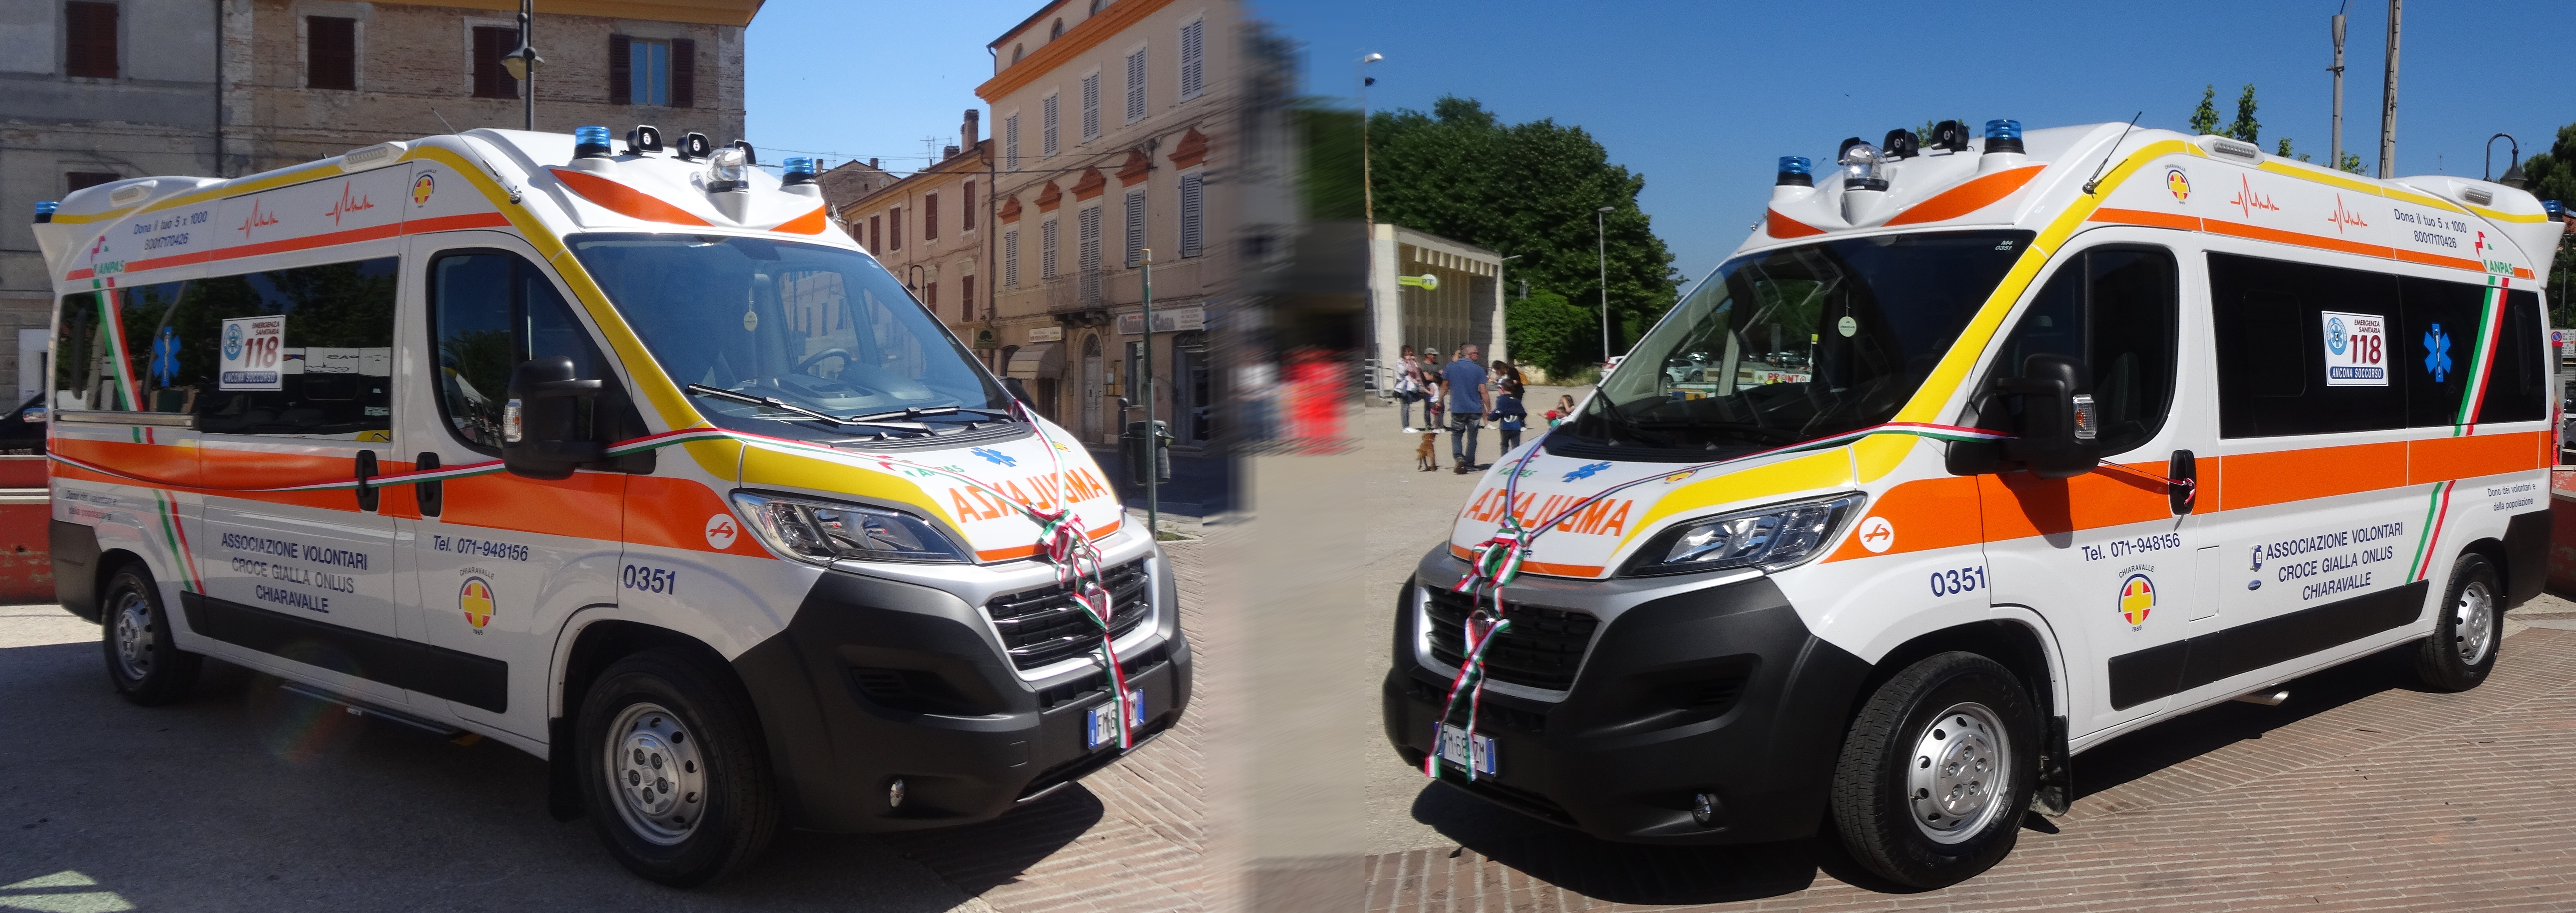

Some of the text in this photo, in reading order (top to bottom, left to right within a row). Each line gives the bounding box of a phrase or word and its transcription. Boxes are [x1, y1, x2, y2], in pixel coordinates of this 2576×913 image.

[133, 224, 151, 235] Dona
[154, 220, 158, 231] il
[160, 220, 172, 230] tuo
[175, 216, 180, 227] 5
[191, 211, 208, 224] 1000
[2394, 208, 2467, 233] Dona il tuo 5 x 1000
[144, 233, 189, 250] 80017170426
[2414, 230, 2457, 249] 80017170426
[99, 259, 125, 275] ANPAS
[2490, 260, 2513, 275] ANPAS
[245, 336, 279, 368] 118
[2349, 334, 2381, 365] 118
[225, 373, 244, 382] ANCONA
[246, 372, 275, 382] SOCCORSO
[2332, 368, 2353, 378] ANCONA
[2355, 368, 2381, 378] SOCCORSO
[2488, 488, 2501, 497] Dono
[2511, 482, 2531, 493] volontari
[2493, 497, 2533, 511] della popolazione
[221, 533, 367, 570] ASSOCIAZIONE VOLONTARI
[434, 535, 528, 561] Tel. 071-948156
[2082, 533, 2180, 562] Tel. 071-948156
[2266, 522, 2403, 560] ASSOCIAZIONE VOLONTARI
[232, 557, 354, 594] CROCE GIALLA ONLUS
[460, 567, 494, 580] CHIARAVALLE
[2119, 564, 2154, 578] CHIARAVALLE
[2278, 545, 2393, 582] CROCE GIALLA ONLUS
[623, 564, 675, 595] 0351
[1931, 566, 1985, 597] 0351
[2303, 572, 2371, 601] CHIARAVALLE
[256, 584, 329, 614] CHIARAVALLE
